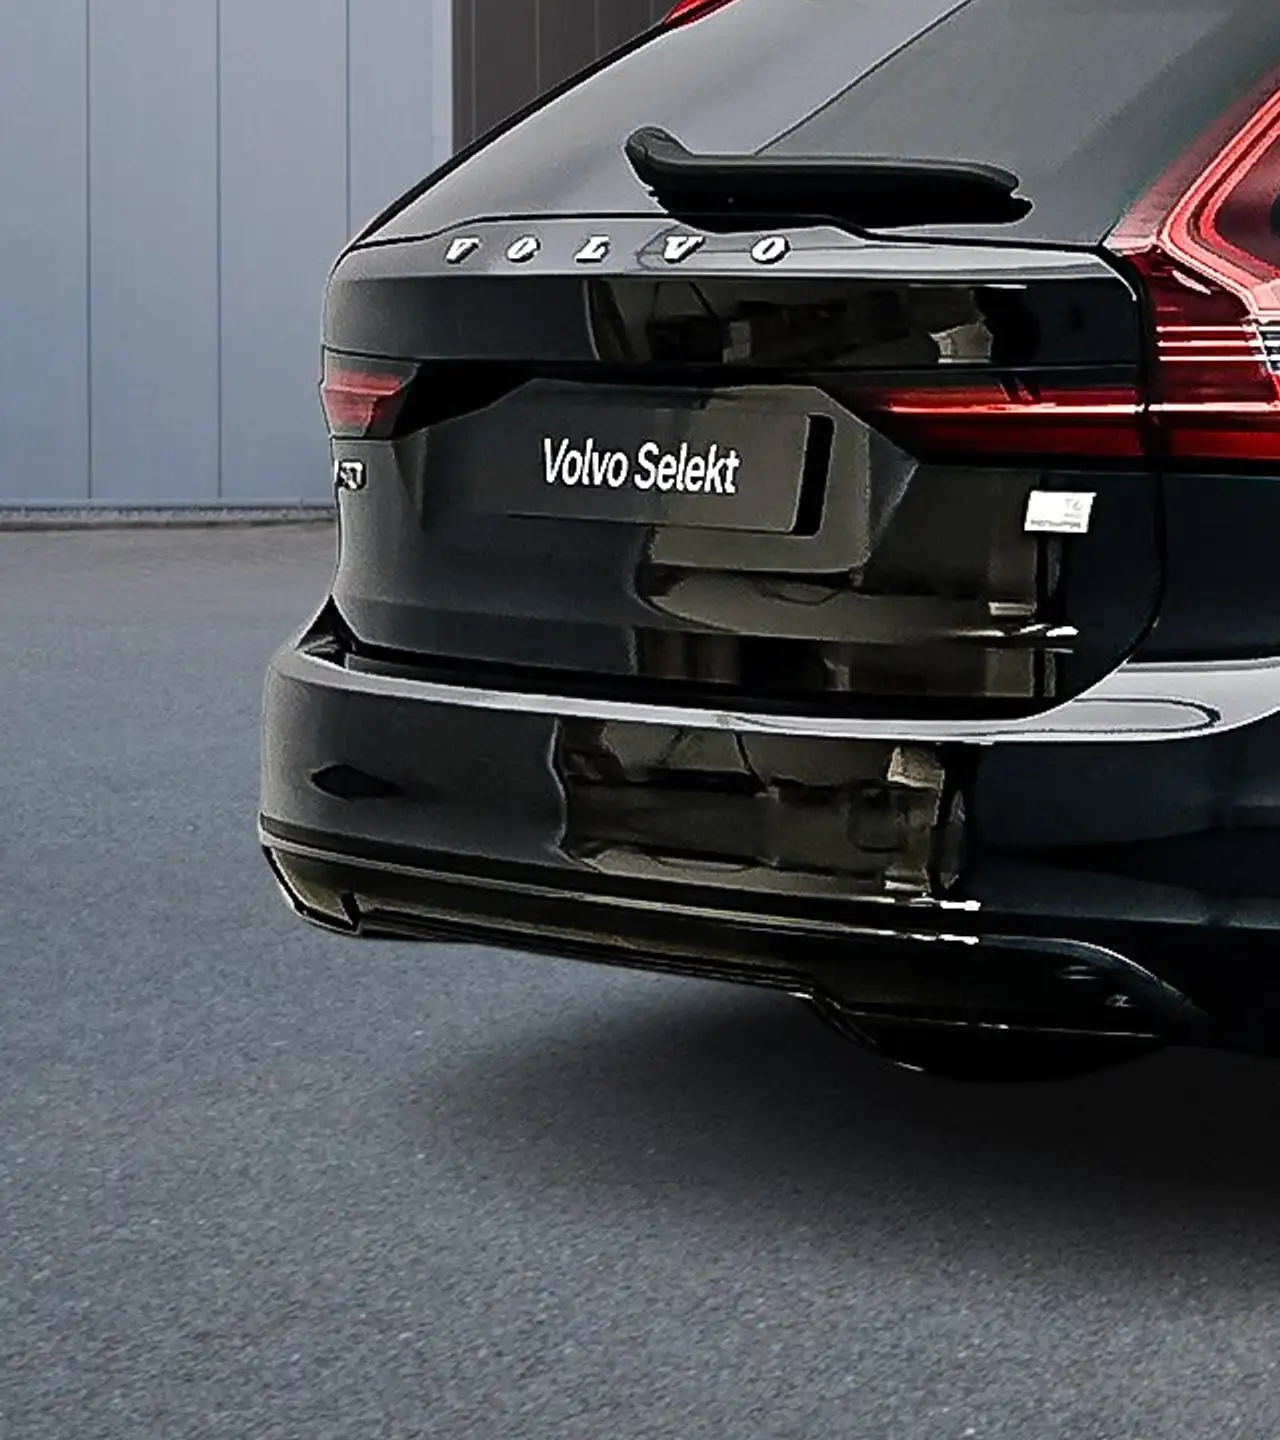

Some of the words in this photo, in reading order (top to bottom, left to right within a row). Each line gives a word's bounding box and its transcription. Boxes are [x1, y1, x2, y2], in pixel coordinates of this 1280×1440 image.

[446, 235, 791, 264] VOLVO
[543, 437, 628, 488] Volvo
[633, 441, 741, 494] Selekt
